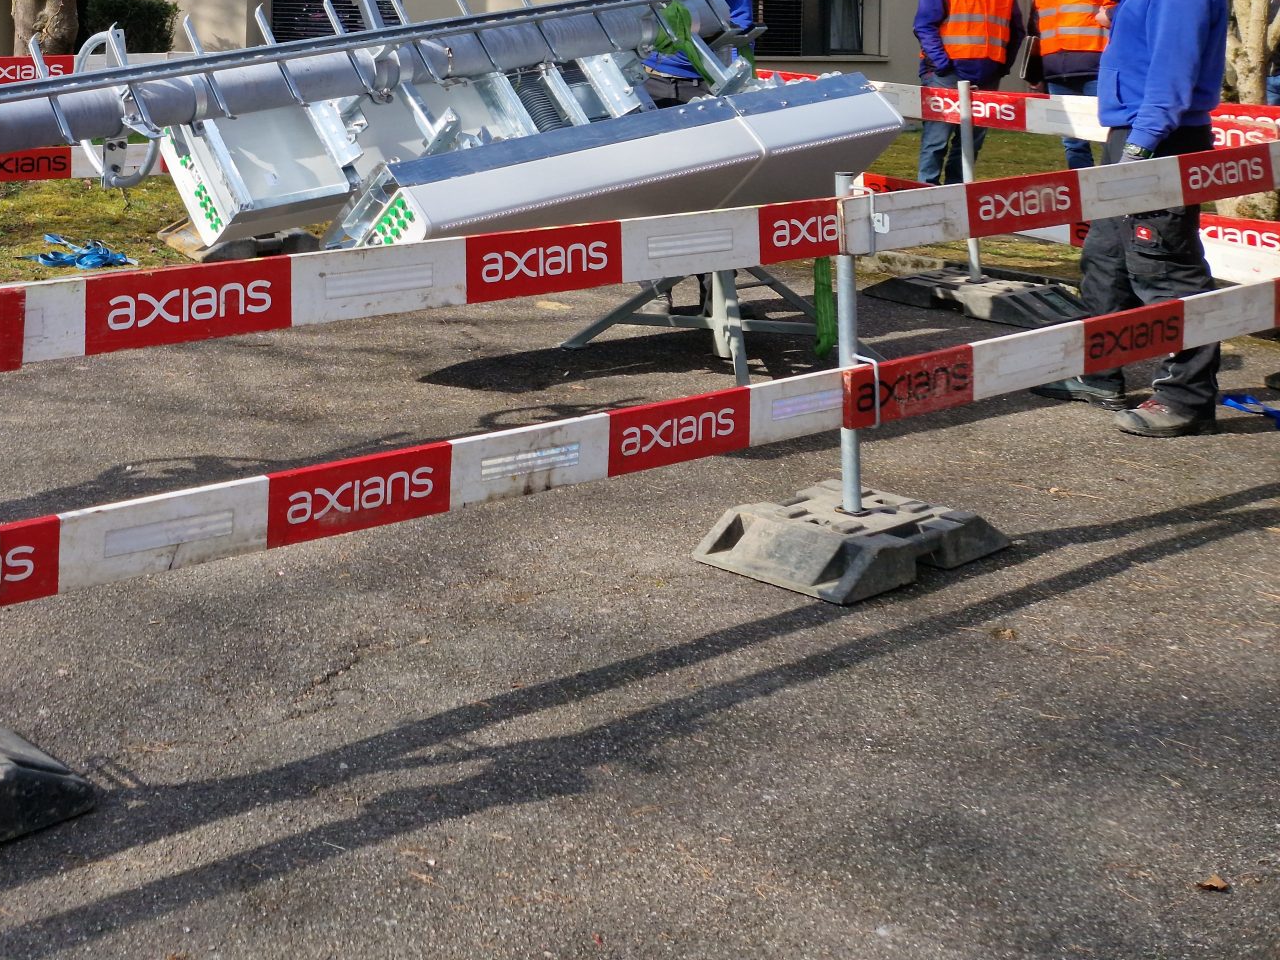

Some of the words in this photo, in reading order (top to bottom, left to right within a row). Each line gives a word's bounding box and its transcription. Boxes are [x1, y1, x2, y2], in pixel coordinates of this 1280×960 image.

[930, 96, 1016, 121] axans
[1188, 157, 1265, 190] axians
[979, 186, 1070, 221] axians
[773, 214, 839, 247] axia
[1199, 225, 1280, 252] xians
[482, 240, 609, 284] axians
[107, 279, 272, 331] axians
[1089, 315, 1179, 359] axians
[856, 361, 969, 413] axians
[621, 408, 735, 457] axians
[287, 466, 434, 525] axians
